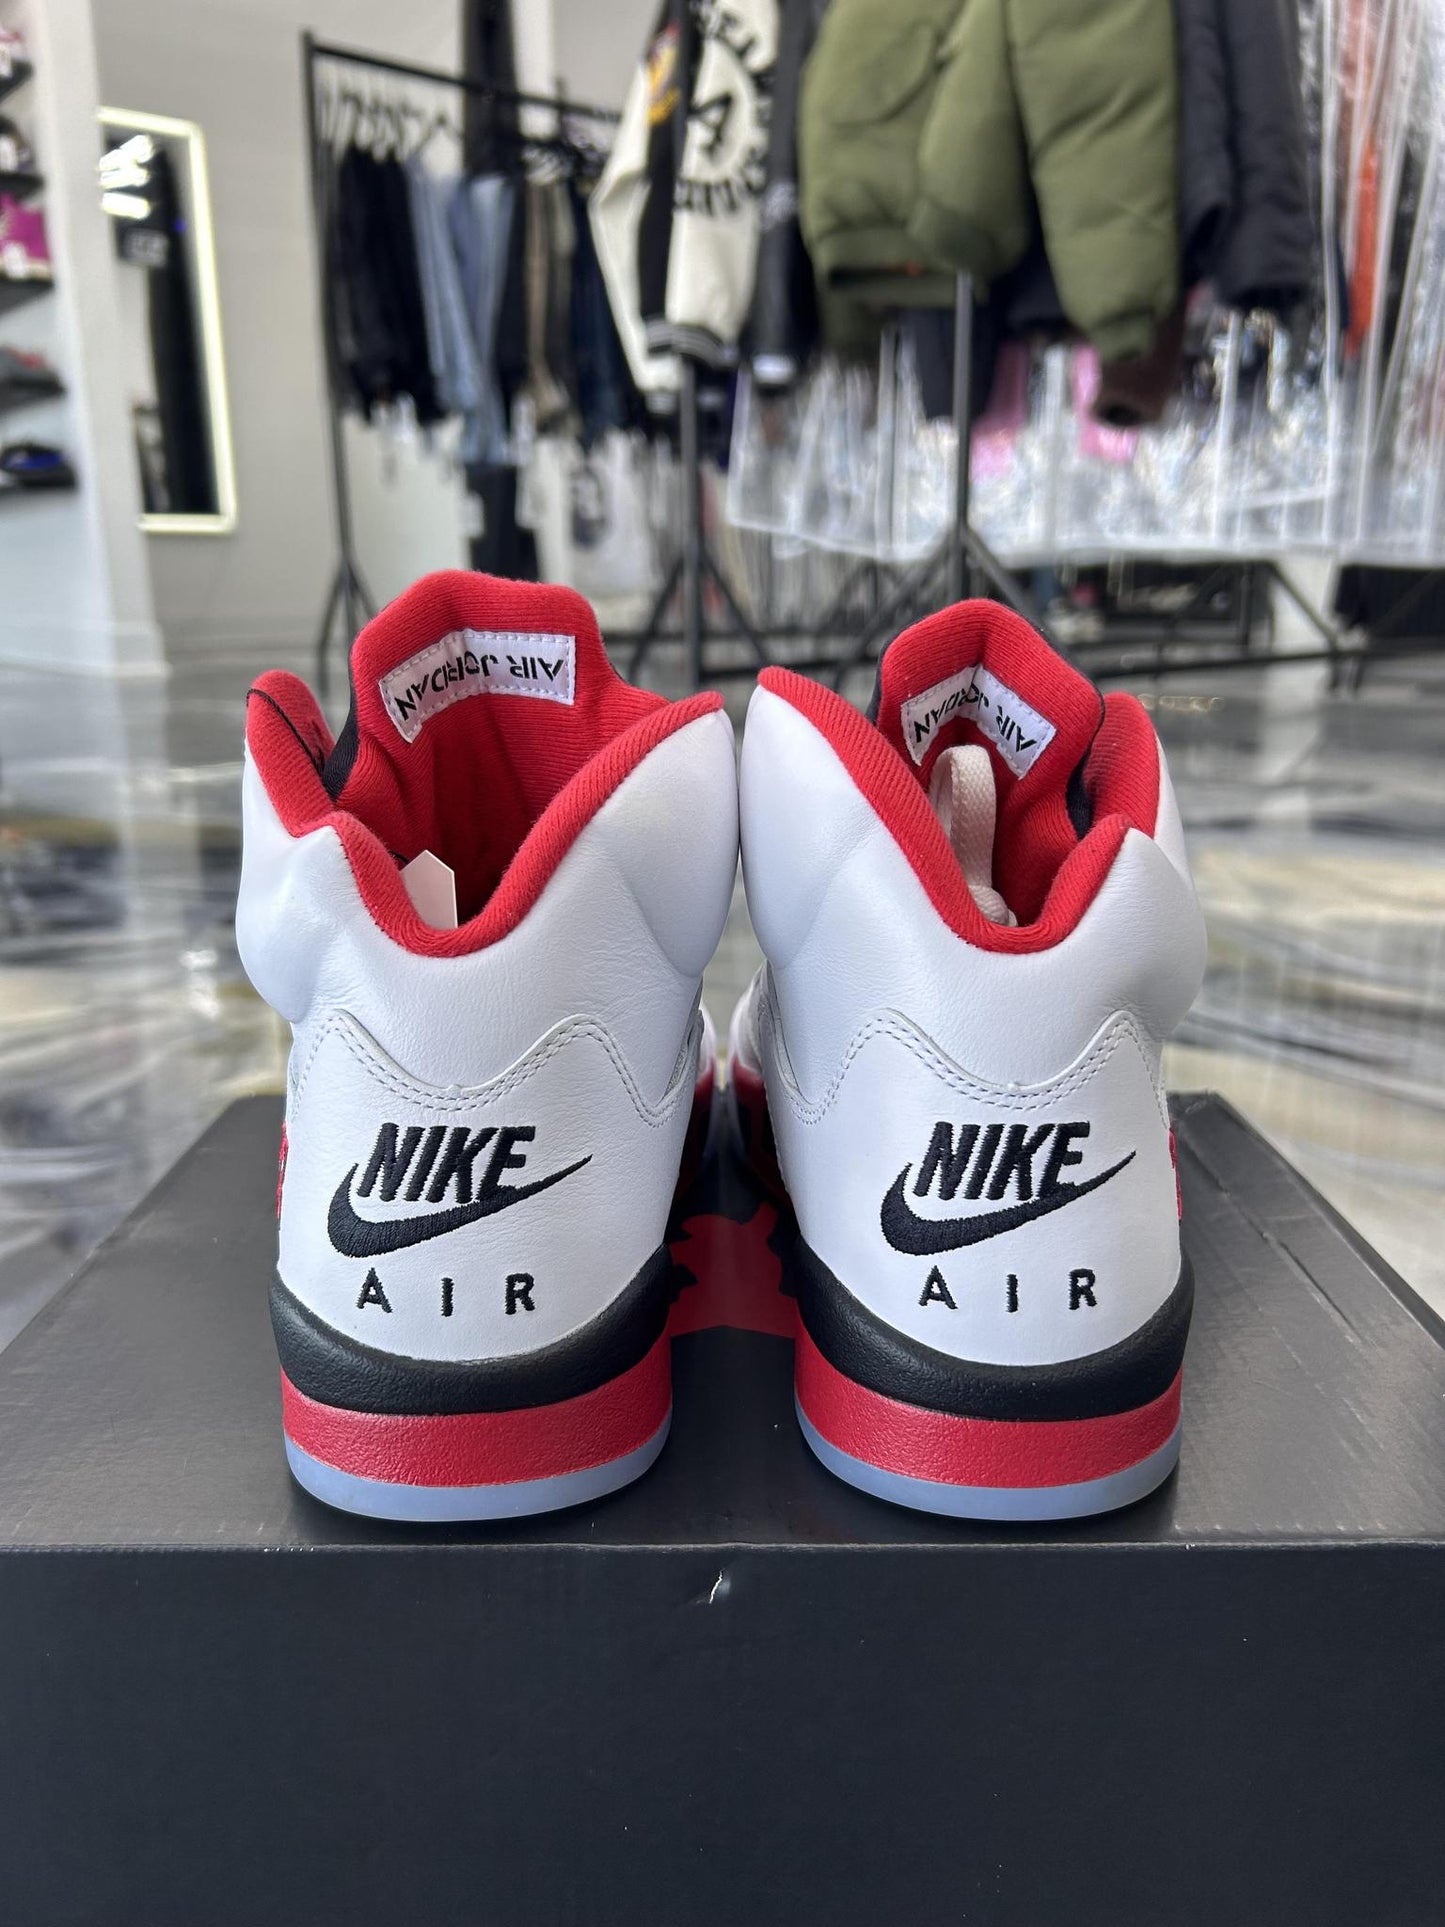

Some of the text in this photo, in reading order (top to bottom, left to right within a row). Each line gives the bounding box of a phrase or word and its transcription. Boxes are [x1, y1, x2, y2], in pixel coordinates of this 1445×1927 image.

[394, 651, 564, 721] AIR JORDAN
[914, 682, 1037, 752] AIR JORDAN
[357, 1122, 536, 1203] NIKE
[912, 1121, 1090, 1201] NIKE
[356, 1267, 536, 1317] AIR
[918, 1265, 1098, 1313] AIR
